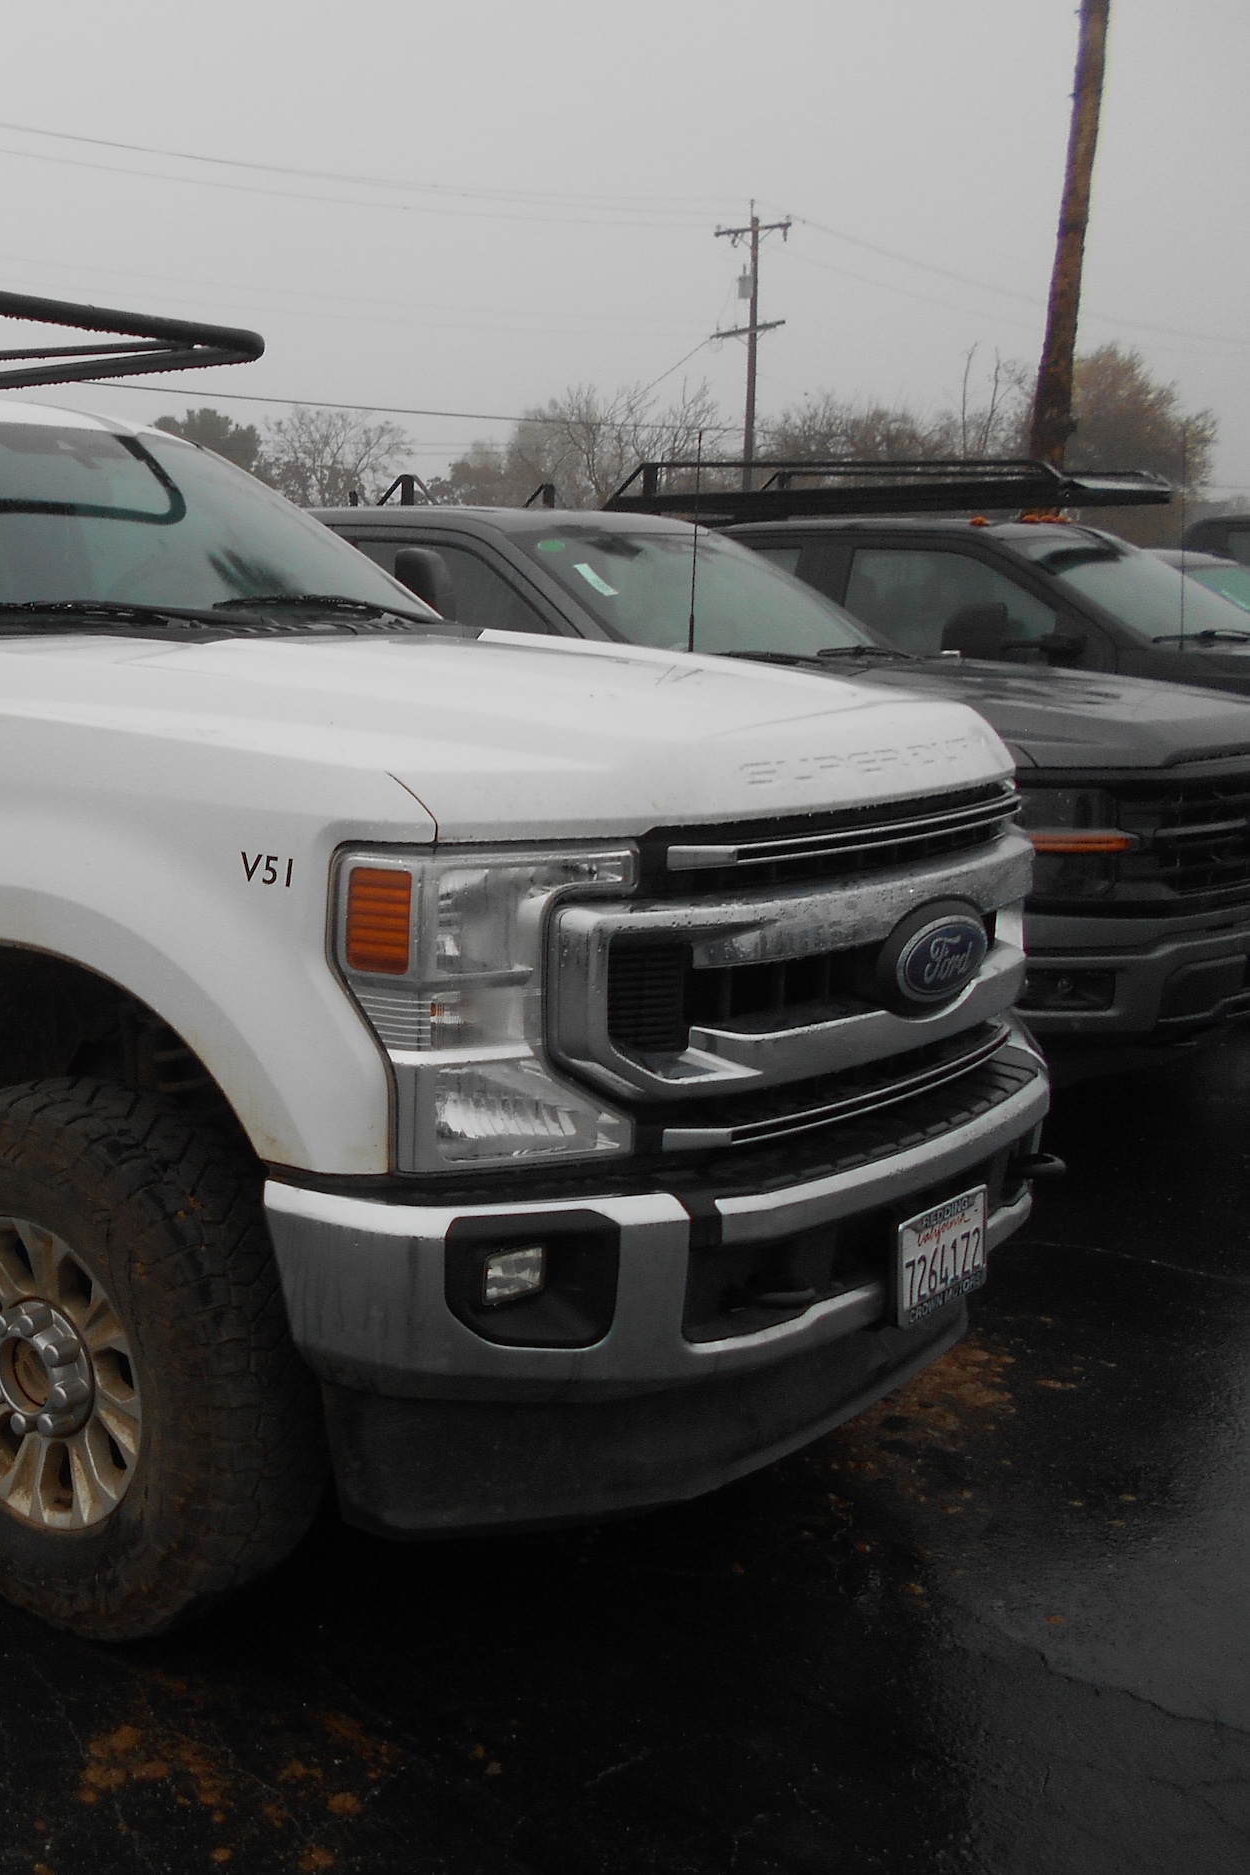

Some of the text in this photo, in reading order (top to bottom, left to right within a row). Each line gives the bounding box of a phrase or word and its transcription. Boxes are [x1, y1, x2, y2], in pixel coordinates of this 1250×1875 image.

[240, 850, 293, 888] V51
[923, 933, 973, 984] Ford
[922, 1195, 969, 1228] REDDING
[917, 1212, 971, 1247] California
[908, 1294, 943, 1324] CROWN
